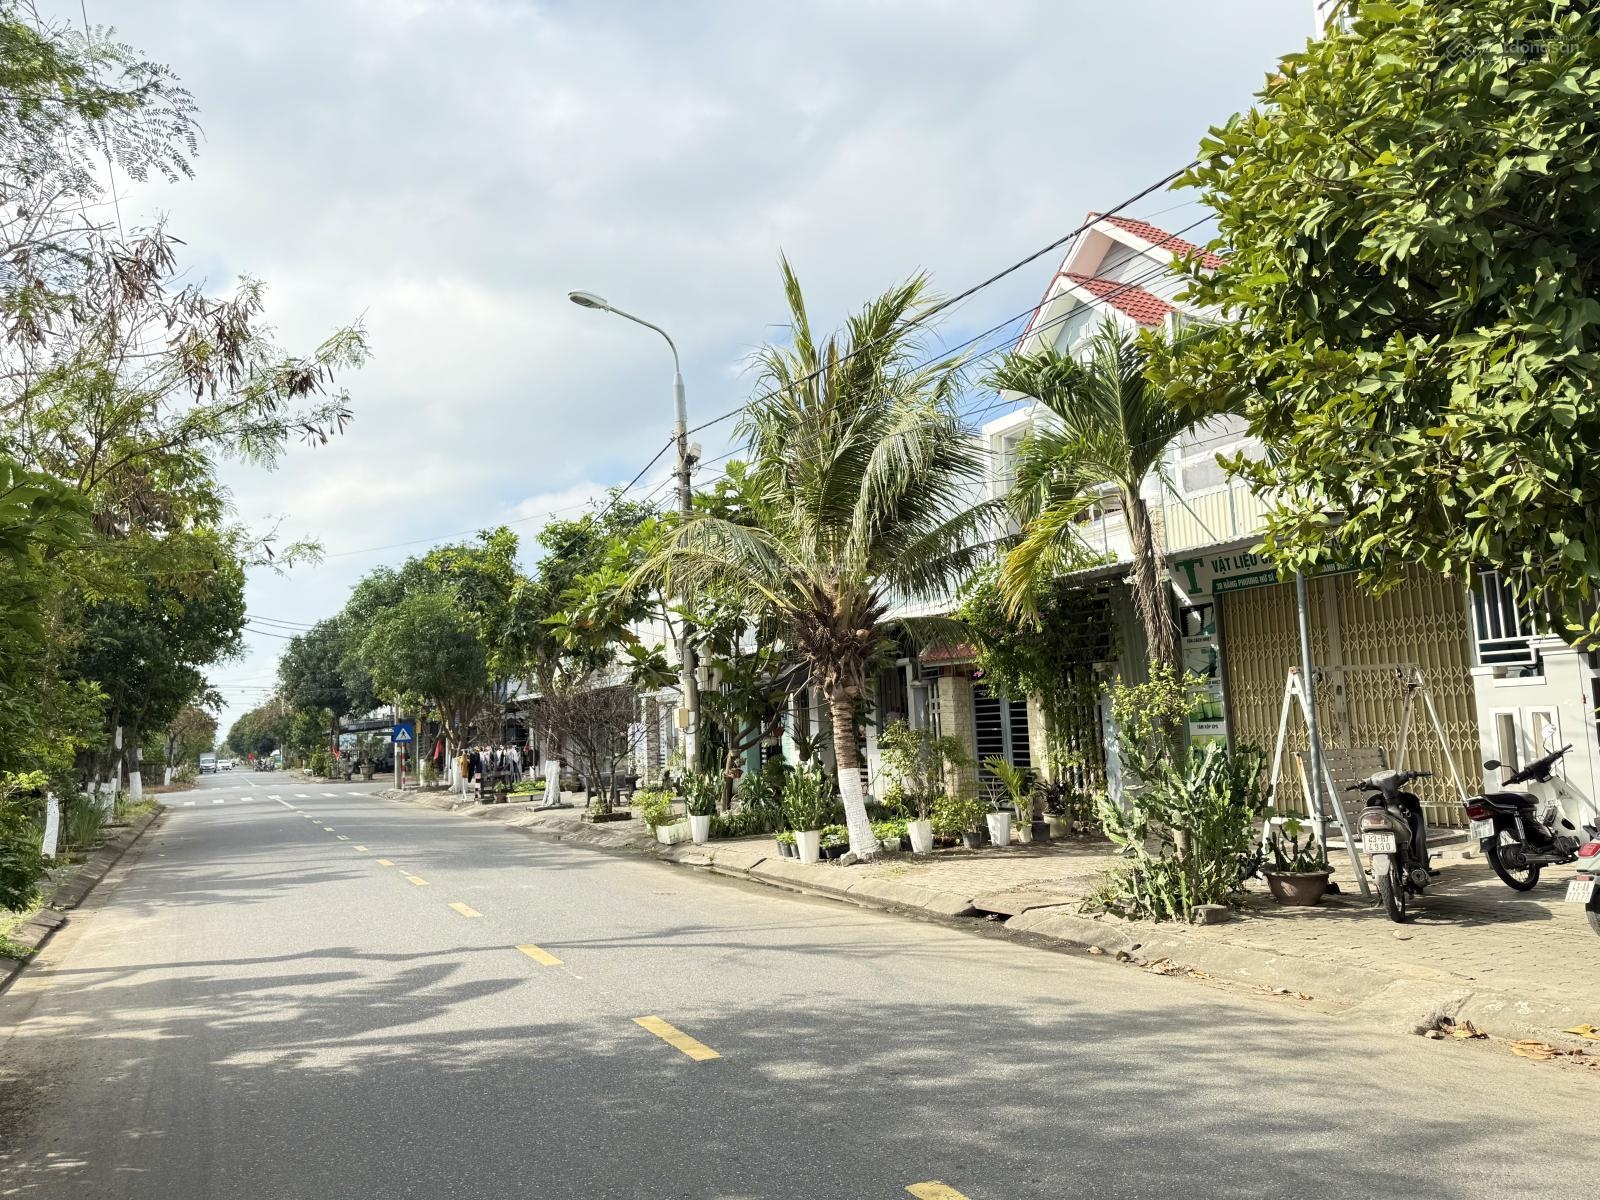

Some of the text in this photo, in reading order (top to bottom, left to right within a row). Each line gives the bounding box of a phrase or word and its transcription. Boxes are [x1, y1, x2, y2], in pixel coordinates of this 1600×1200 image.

[1174, 558, 1204, 594] T
[1211, 556, 1231, 574] VẬT
[1232, 551, 1258, 570] LIỆU
